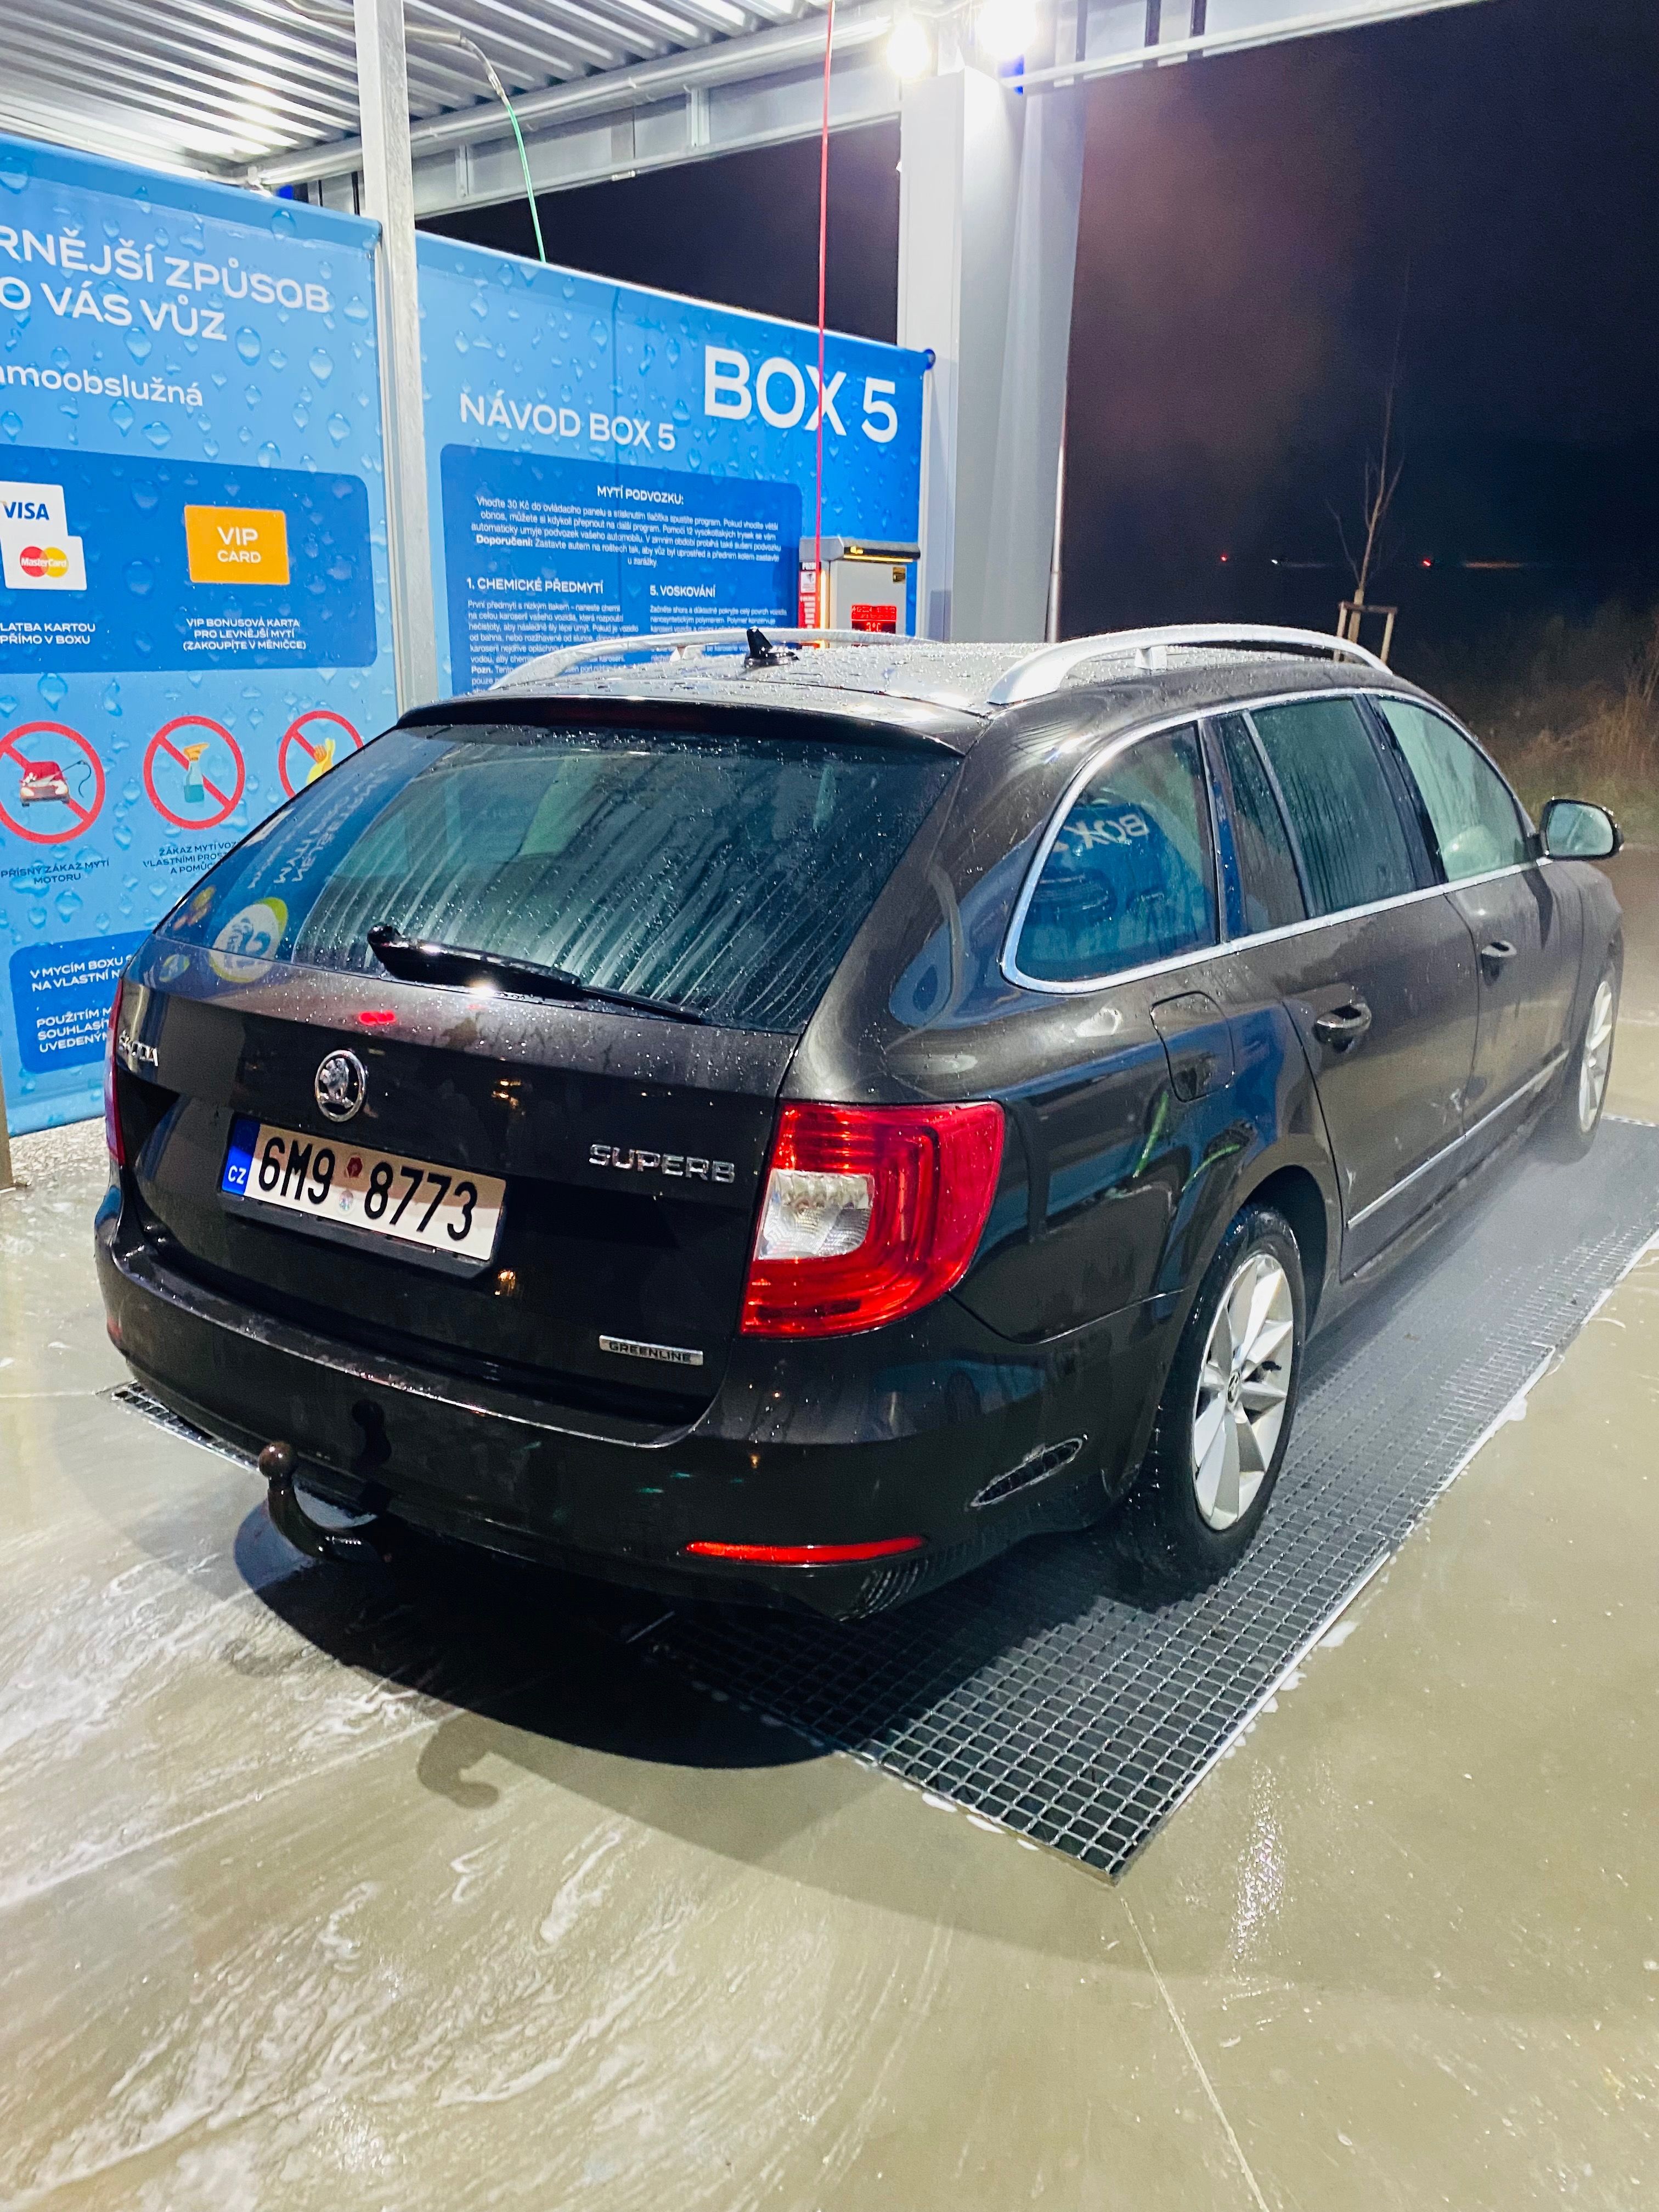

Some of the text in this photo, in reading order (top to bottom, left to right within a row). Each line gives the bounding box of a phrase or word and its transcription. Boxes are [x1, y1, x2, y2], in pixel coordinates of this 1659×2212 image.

[165, 257, 330, 313] ZPŮSOB
[41, 280, 132, 326] VÁS
[140, 294, 227, 341] VŮZ
[704, 345, 898, 443] BOX 5
[460, 390, 675, 452] NÁVOD BOX 5
[507, 499, 517, 509] 30
[532, 501, 541, 511] do
[597, 485, 684, 505] MYTÍ PODVOZKU:
[1, 500, 49, 520] VISA
[217, 526, 258, 546] VIP
[20, 557, 67, 568] MasterCard
[217, 550, 262, 564] CARD
[466, 577, 603, 594] 1. CHEMICKÉ PŘEDMYTÍ
[650, 584, 715, 597] 5. VOSKOVÁNÍ
[1, 622, 95, 633] LATBA KARTOU
[186, 616, 301, 628] VIP BONUSOVÁ KARTA
[0, 632, 91, 645] PŘÍMO V BOXU
[194, 627, 295, 639] PRO LEVNĚJŠÍ MYTÍ
[249, 641, 256, 650] V
[471, 665, 493, 674] Pozn.
[159, 845, 192, 856] ZÁKAZ
[194, 841, 216, 853] MYTÍ
[1, 856, 110, 878] PŘÍSNÝ ZÁKAZ MYTÍ
[143, 856, 195, 867] VLASTNÍMI
[34, 873, 82, 884] MOTORU
[30, 969, 40, 979] V
[42, 962, 85, 978] MYCÍM
[88, 956, 123, 970] BOXU
[32, 980, 52, 992] NA
[53, 969, 109, 988] VLASTNÍ
[36, 1008, 99, 1028] POUŽITÍM
[589, 1144, 735, 1183] SUPERB
[228, 1165, 246, 1185] CZ
[258, 1137, 478, 1242] 6M9 8773
[609, 1341, 691, 1363] GREENLINE
